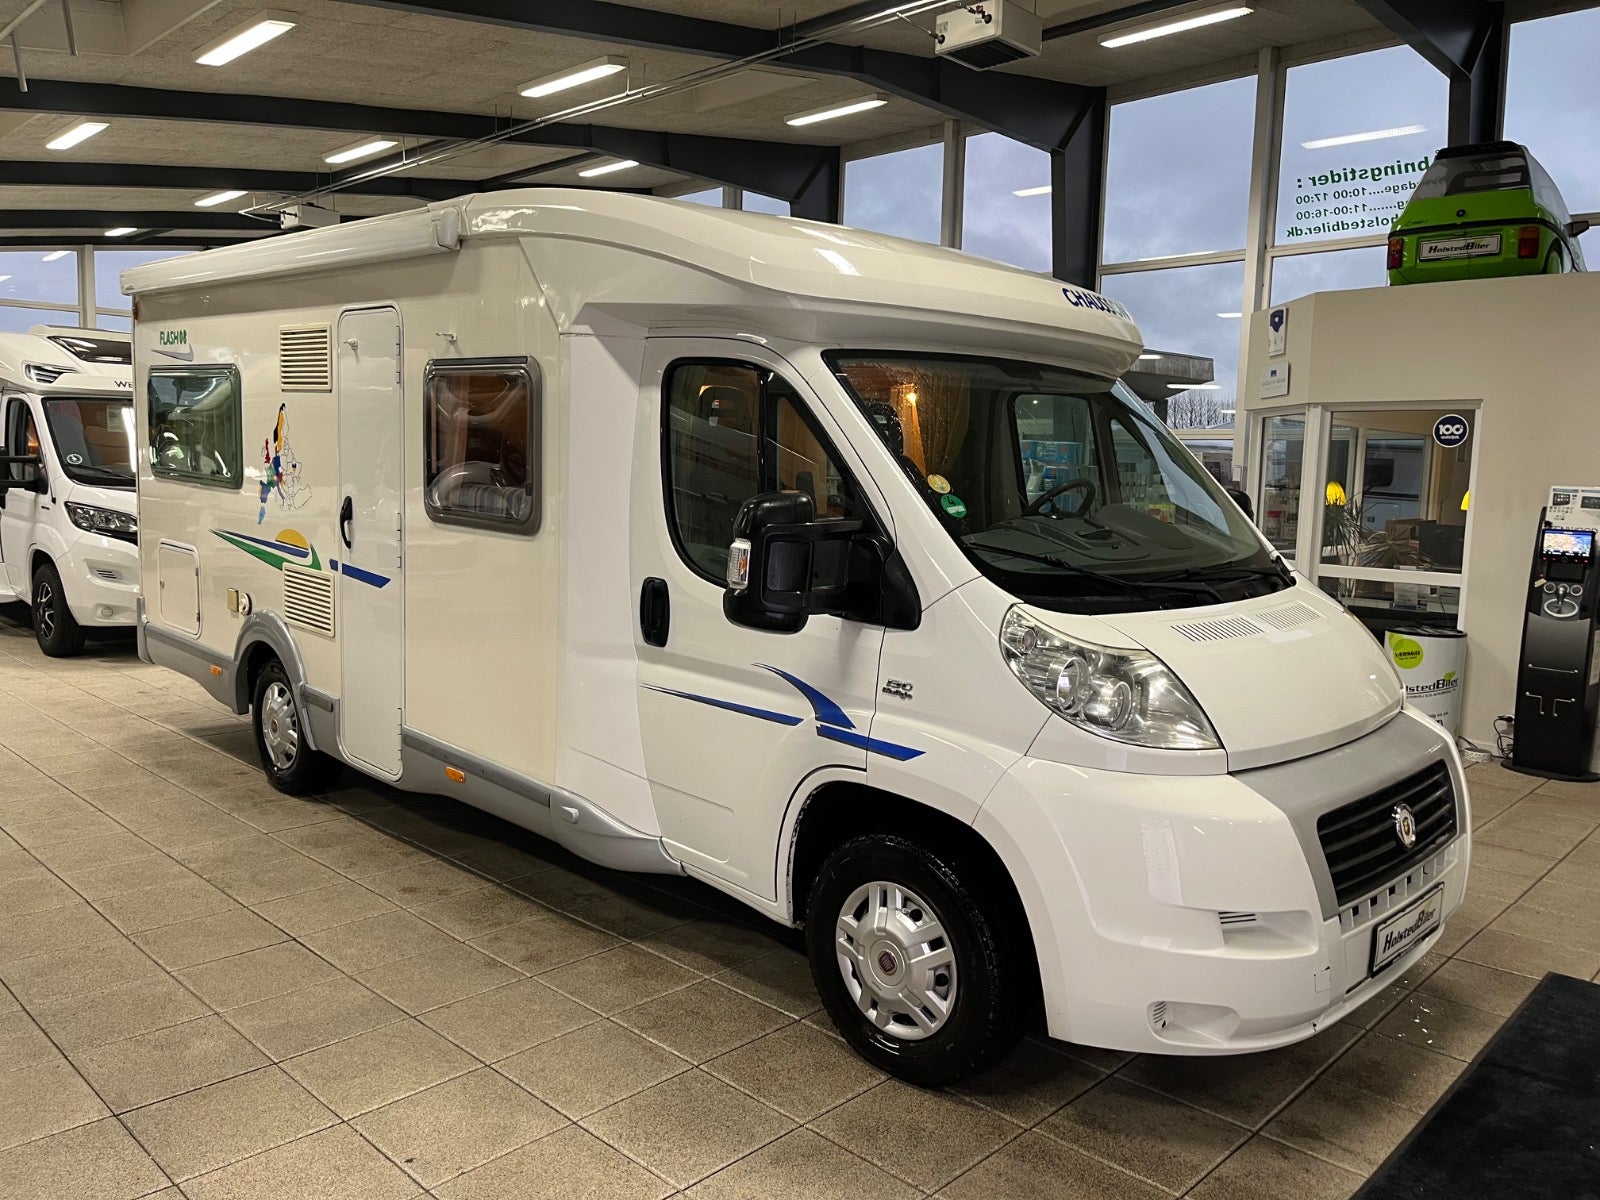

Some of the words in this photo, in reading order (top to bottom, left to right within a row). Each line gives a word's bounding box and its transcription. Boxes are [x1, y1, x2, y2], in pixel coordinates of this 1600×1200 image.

[1428, 241, 1491, 254] HolstedBiler
[160, 331, 179, 346] FLASH
[114, 380, 134, 389] WE
[1406, 678, 1459, 693] lstedBiler
